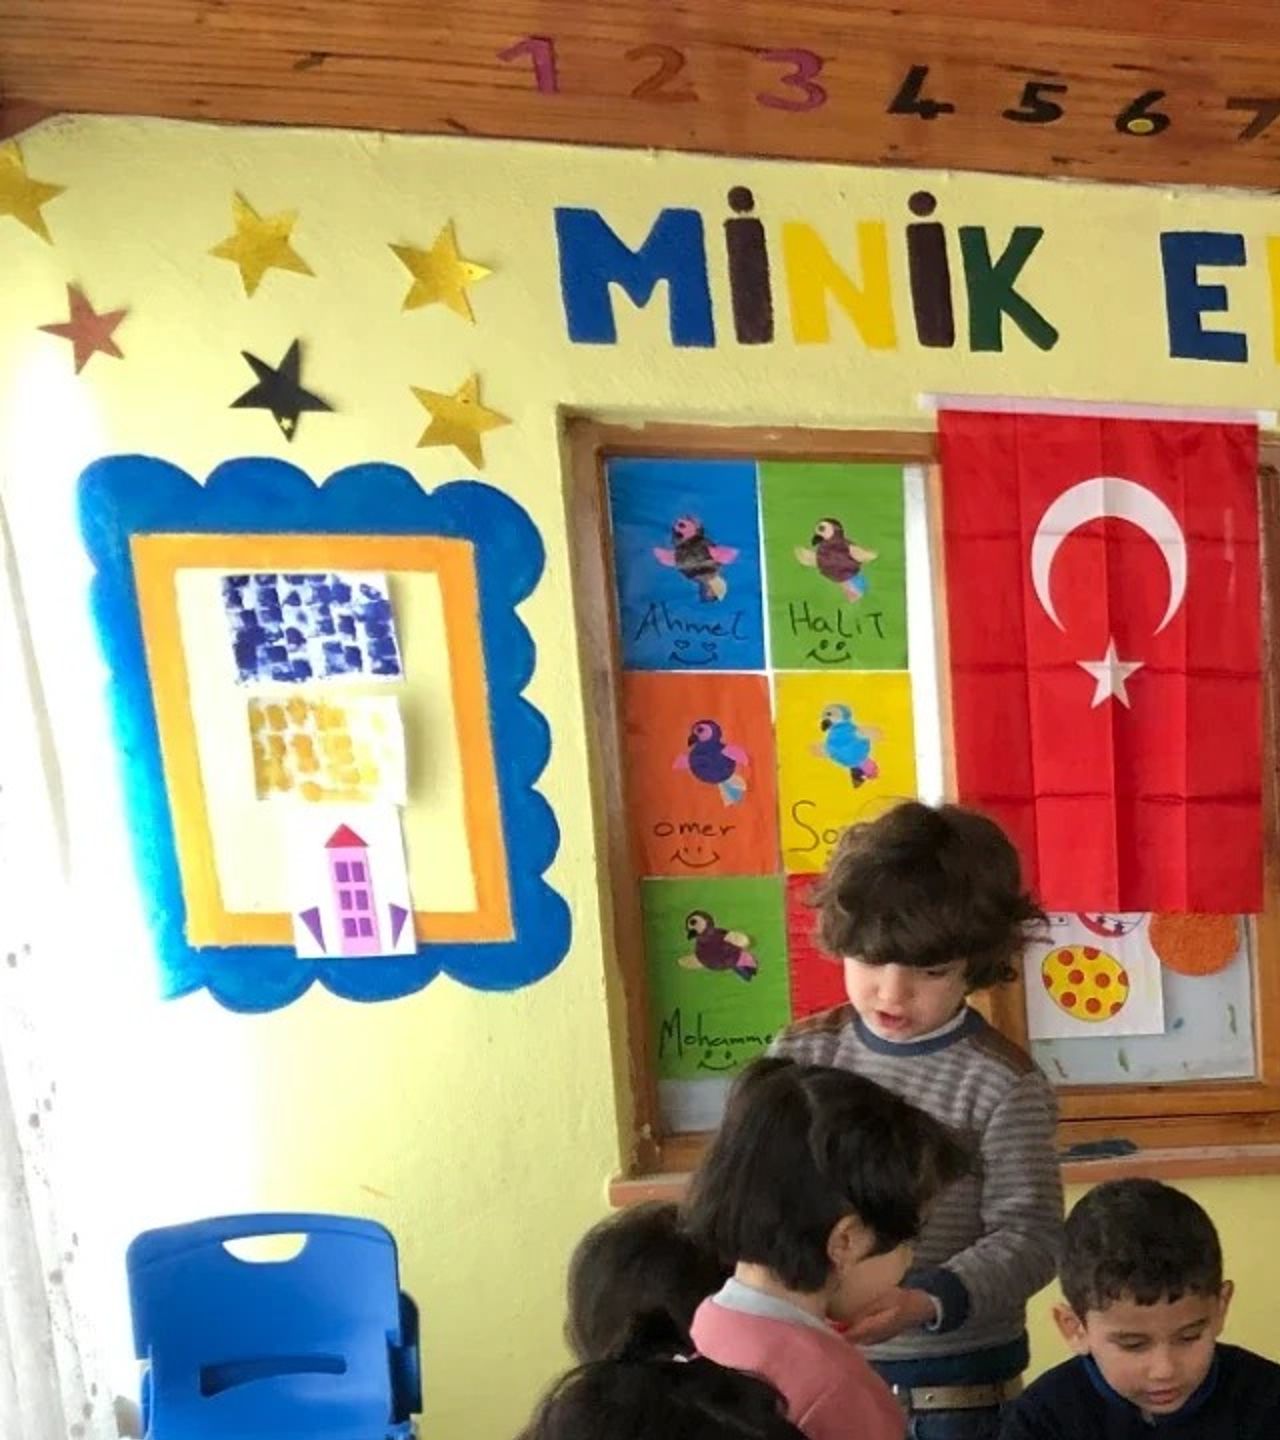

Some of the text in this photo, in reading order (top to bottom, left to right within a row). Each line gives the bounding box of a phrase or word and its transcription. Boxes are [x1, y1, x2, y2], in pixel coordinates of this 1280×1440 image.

[497, 34, 559, 96] 1
[625, 45, 698, 104] 2
[755, 50, 827, 112] 3
[887, 65, 955, 120] 4
[1002, 81, 1068, 124] 5
[1114, 90, 1171, 137] 6
[554, 185, 1059, 353] MİNİK
[658, 1007, 773, 1058] Mohamme
